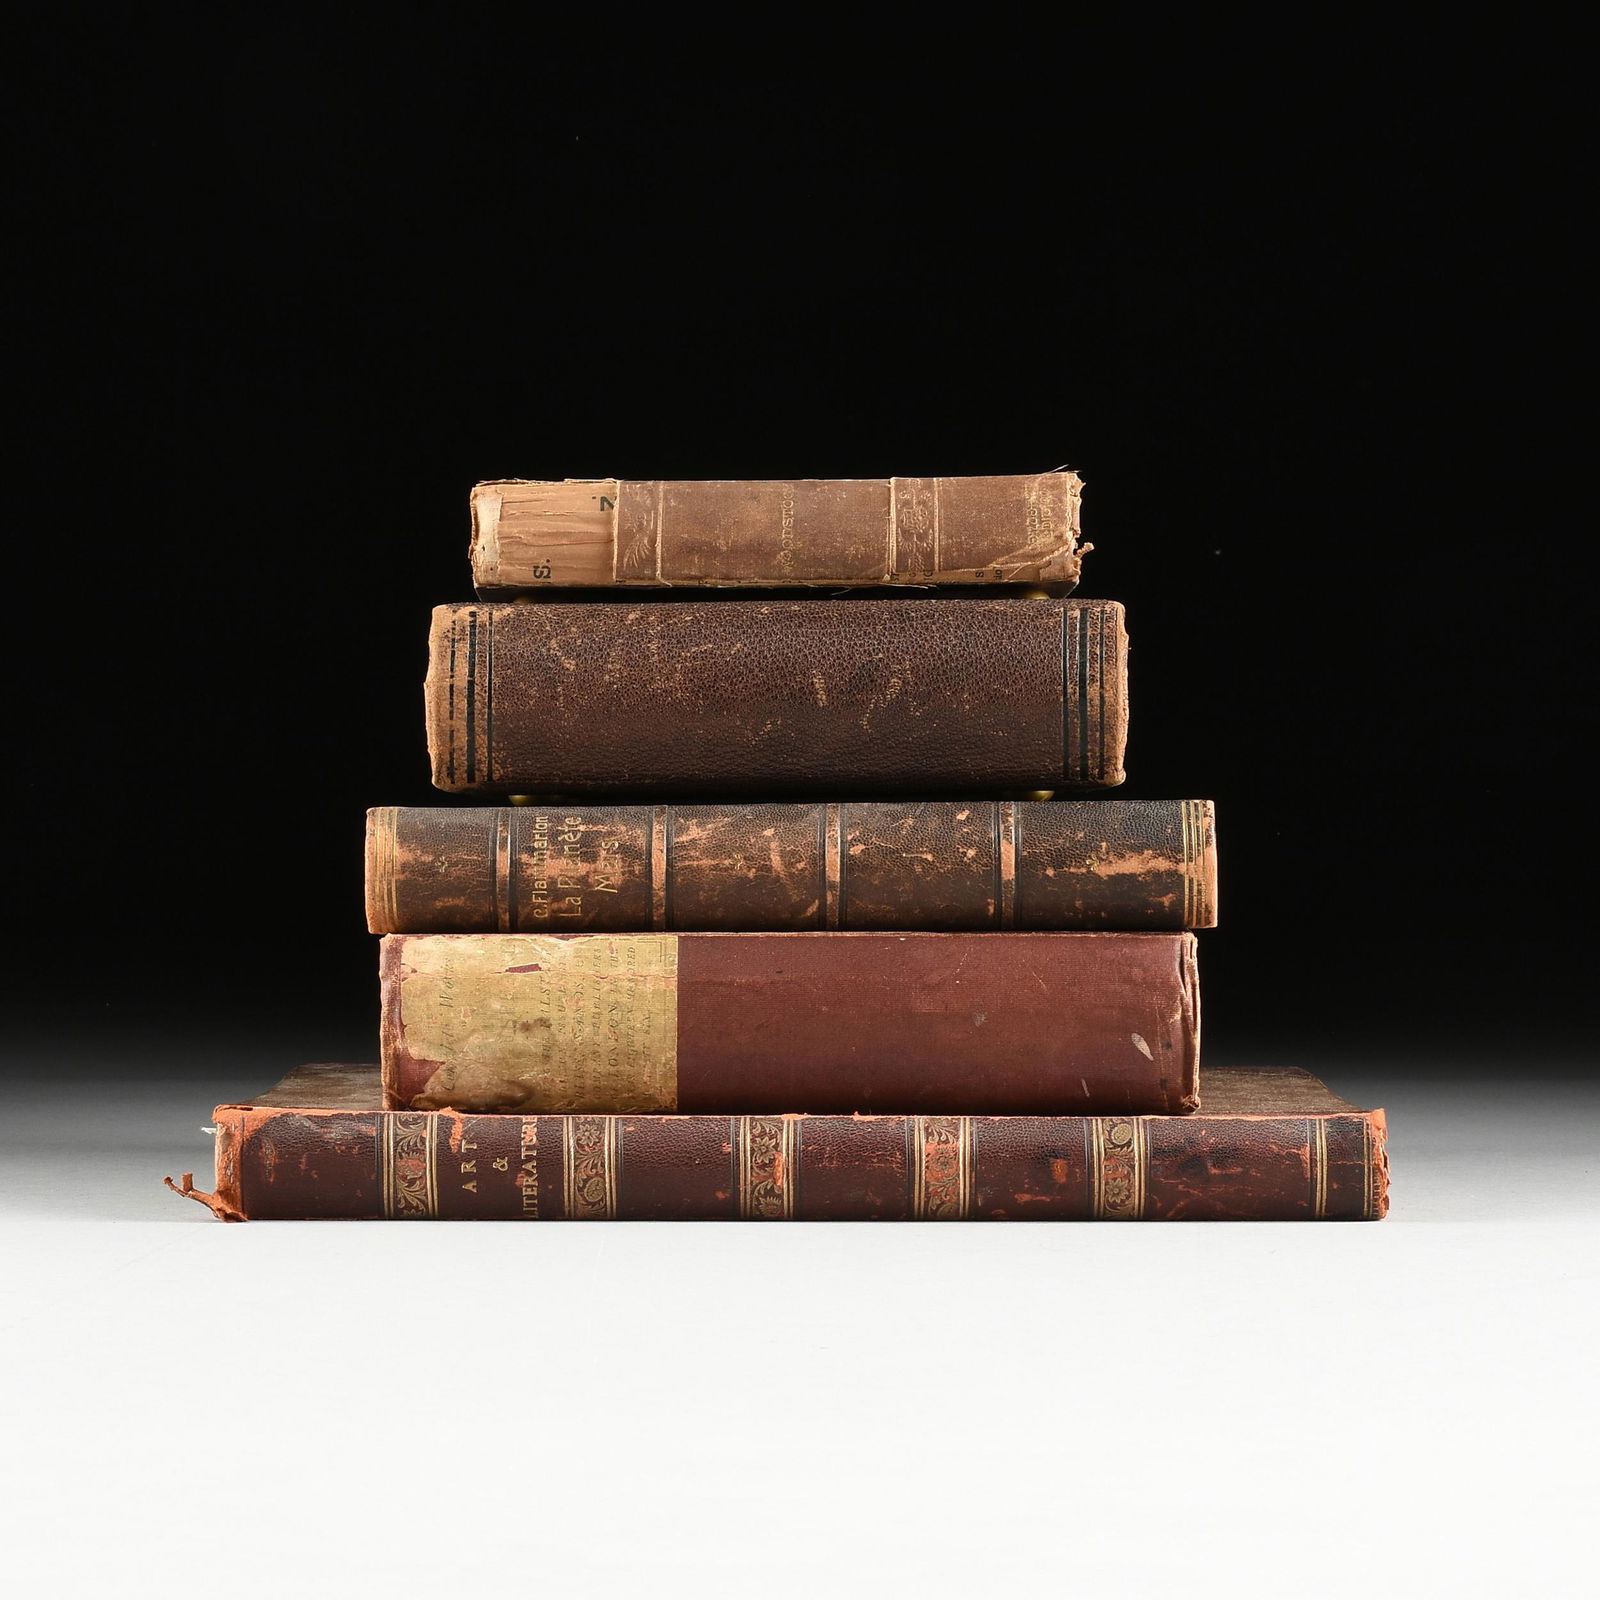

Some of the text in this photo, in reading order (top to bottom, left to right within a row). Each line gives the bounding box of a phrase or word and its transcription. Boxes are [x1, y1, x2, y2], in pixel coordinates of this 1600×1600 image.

[594, 839, 619, 894] Mars
[558, 896, 582, 917] La
[460, 1138, 478, 1194] ART
[491, 1156, 509, 1172] &
[520, 1114, 540, 1219] LITERATURE
